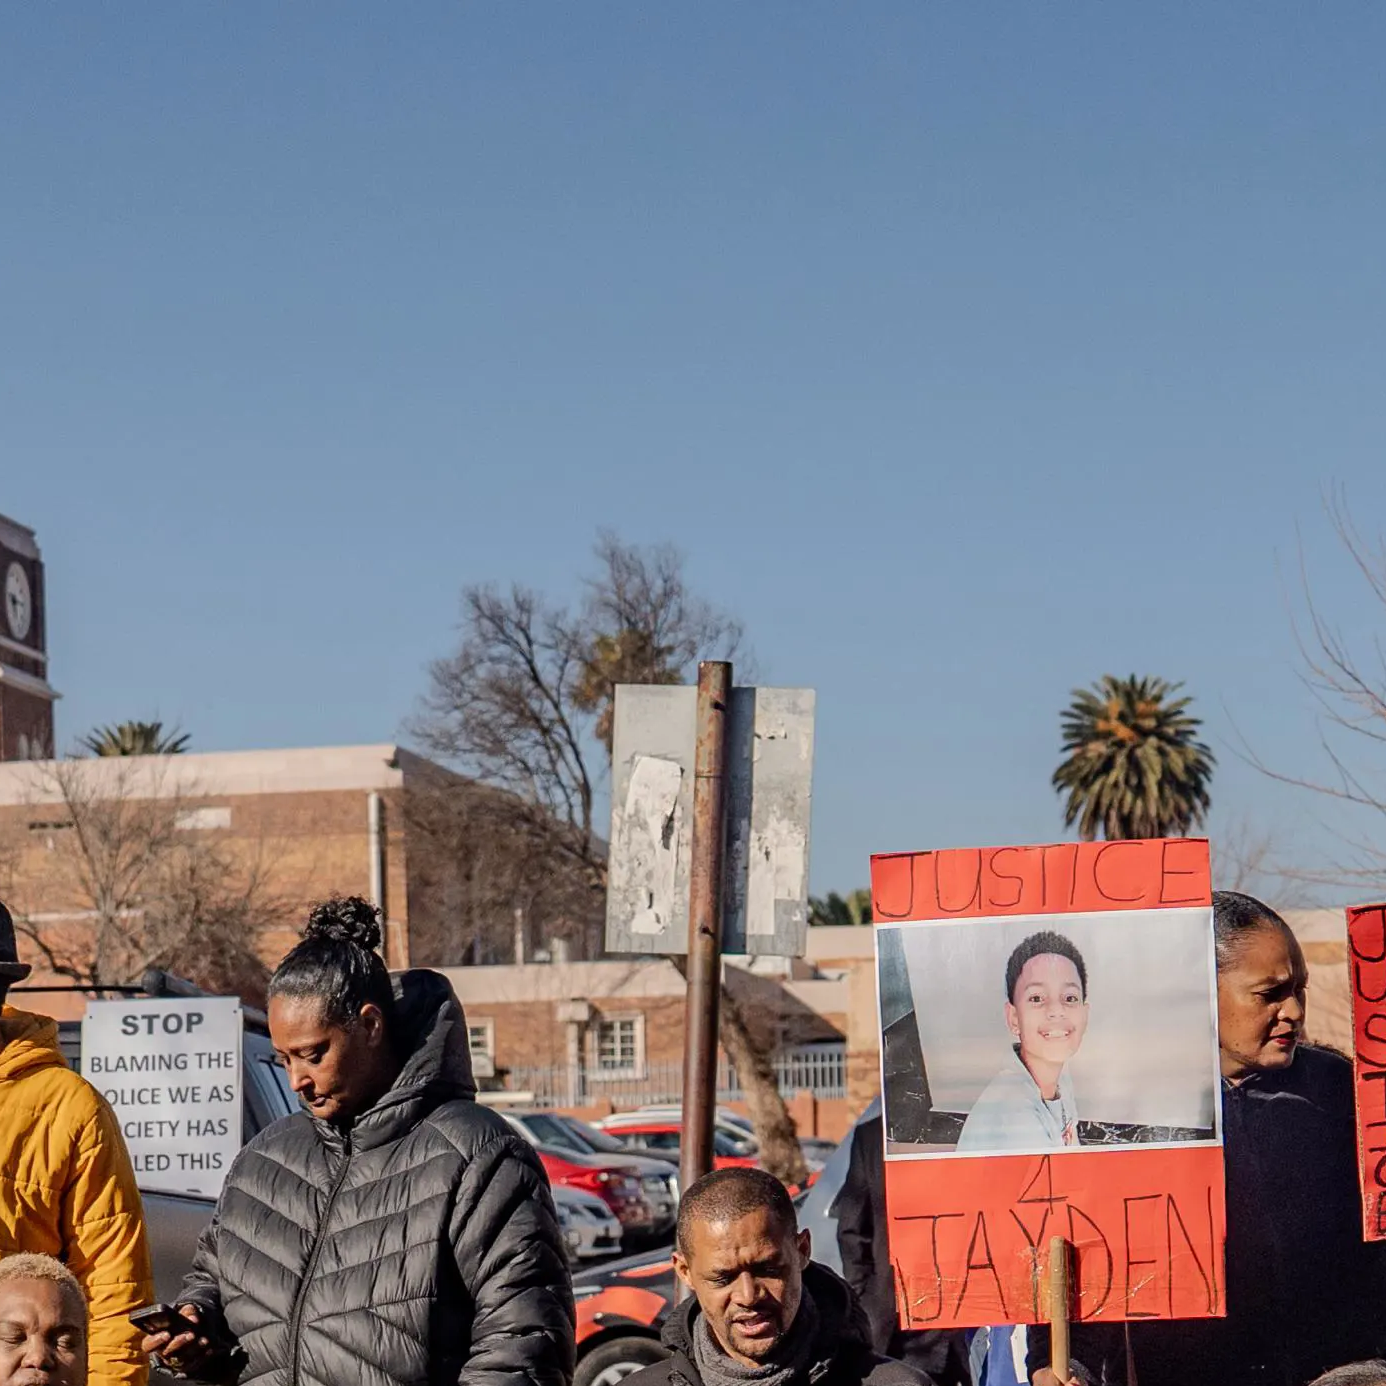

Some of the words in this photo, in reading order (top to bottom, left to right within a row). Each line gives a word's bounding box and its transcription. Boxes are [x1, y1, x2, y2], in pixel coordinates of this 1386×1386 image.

[874, 838, 1206, 918] JUSTICE
[121, 1012, 204, 1036] STOP
[90, 1053, 188, 1073] BLAMING
[195, 1051, 234, 1069] THE
[102, 1088, 161, 1106] OLICE
[168, 1086, 201, 1104] WE
[208, 1085, 234, 1102] AS
[124, 1120, 179, 1139] CIETY
[187, 1119, 228, 1136] HAS
[134, 1154, 170, 1172] LED
[177, 1152, 223, 1171] THIS
[1017, 1154, 1068, 1215] 4
[895, 1187, 1215, 1329] JAYDEN
